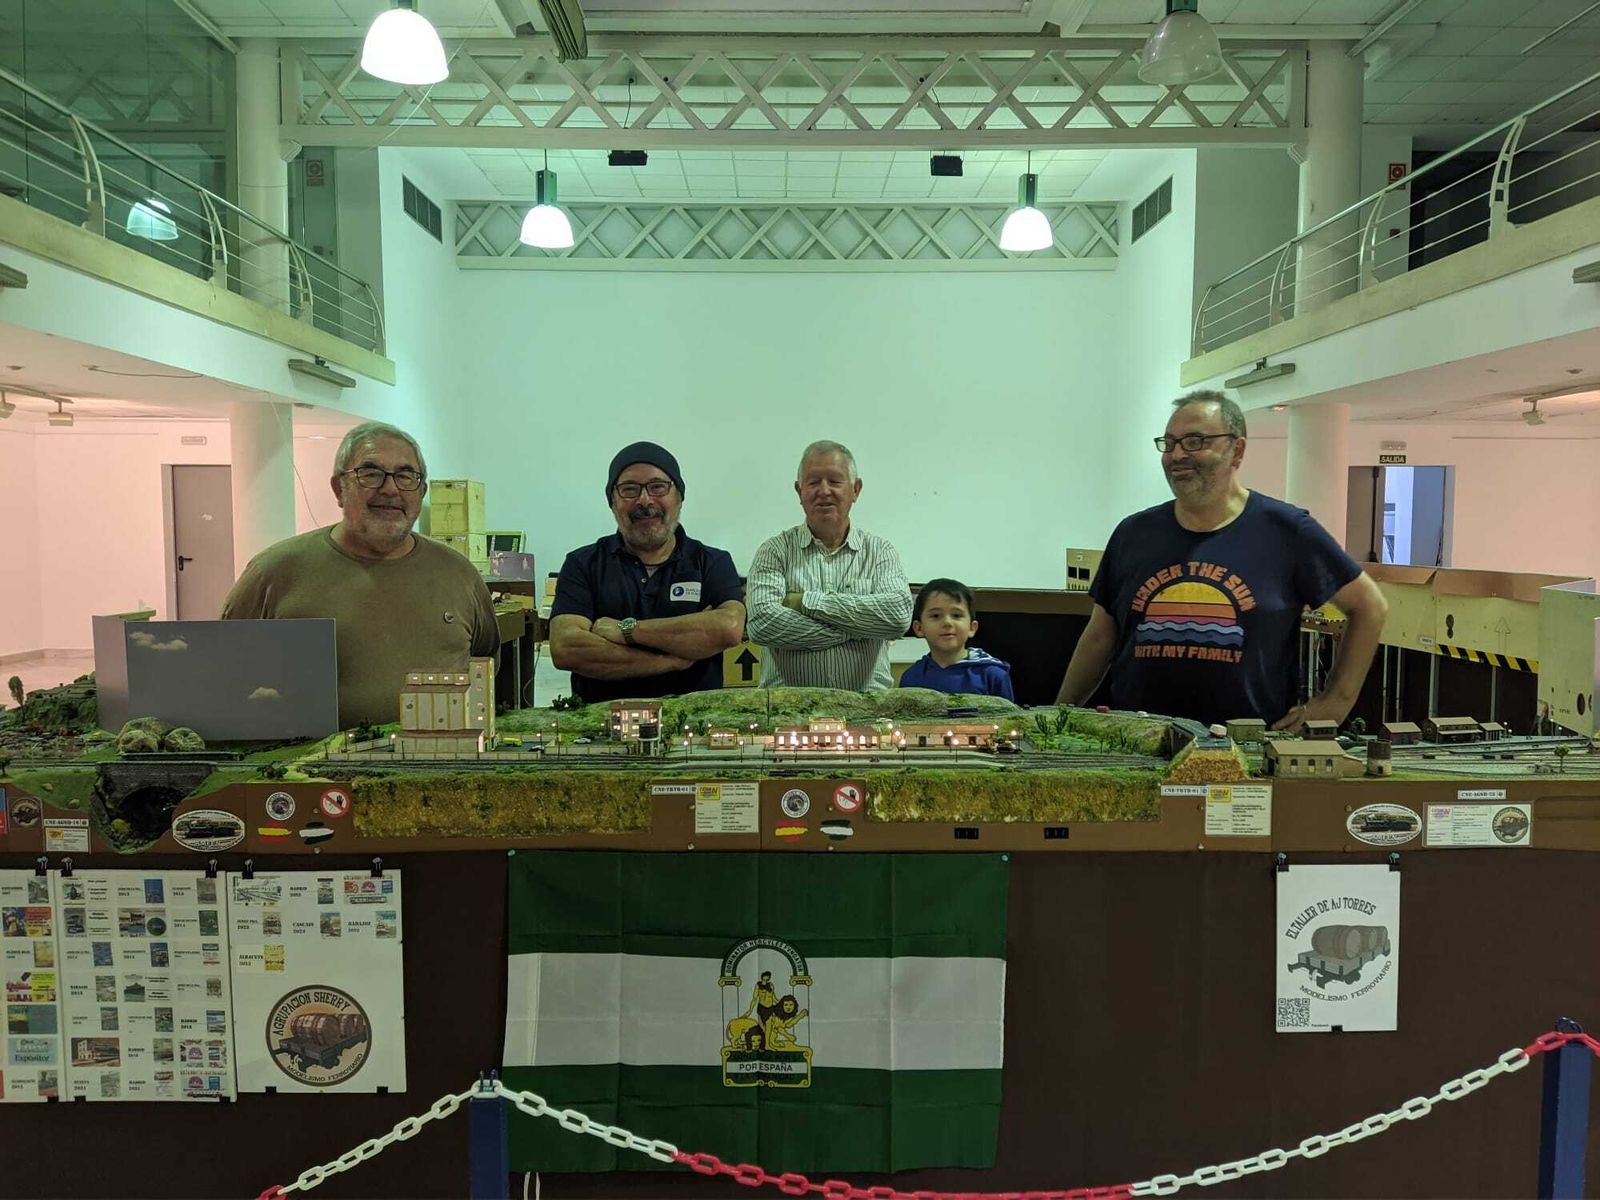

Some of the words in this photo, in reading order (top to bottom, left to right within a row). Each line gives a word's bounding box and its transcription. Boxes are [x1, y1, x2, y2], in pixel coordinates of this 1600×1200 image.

[1132, 564, 1183, 612] UNDER
[1187, 561, 1227, 582] THE
[1223, 574, 1256, 612] SUN
[1135, 645, 1160, 658] WITH
[1162, 645, 1186, 658] MY
[1188, 646, 1243, 663] FAMILY
[1317, 900, 1330, 914] DE
[1331, 898, 1342, 910] AJ
[1343, 897, 1377, 916] TORRES
[1290, 905, 1319, 931] TALLER
[1285, 929, 1300, 940] EL
[1299, 985, 1348, 1002] MODELISMO
[1350, 960, 1392, 1000] FERROVIARIO
[272, 992, 312, 1036] AGRUPACION
[313, 991, 351, 1012] SHERRY
[287, 1065, 325, 1082] MODELISMO
[327, 1053, 363, 1081] FERROVIARIO
[739, 1063, 757, 1072] POR
[759, 1062, 793, 1072] ESPAÑA
